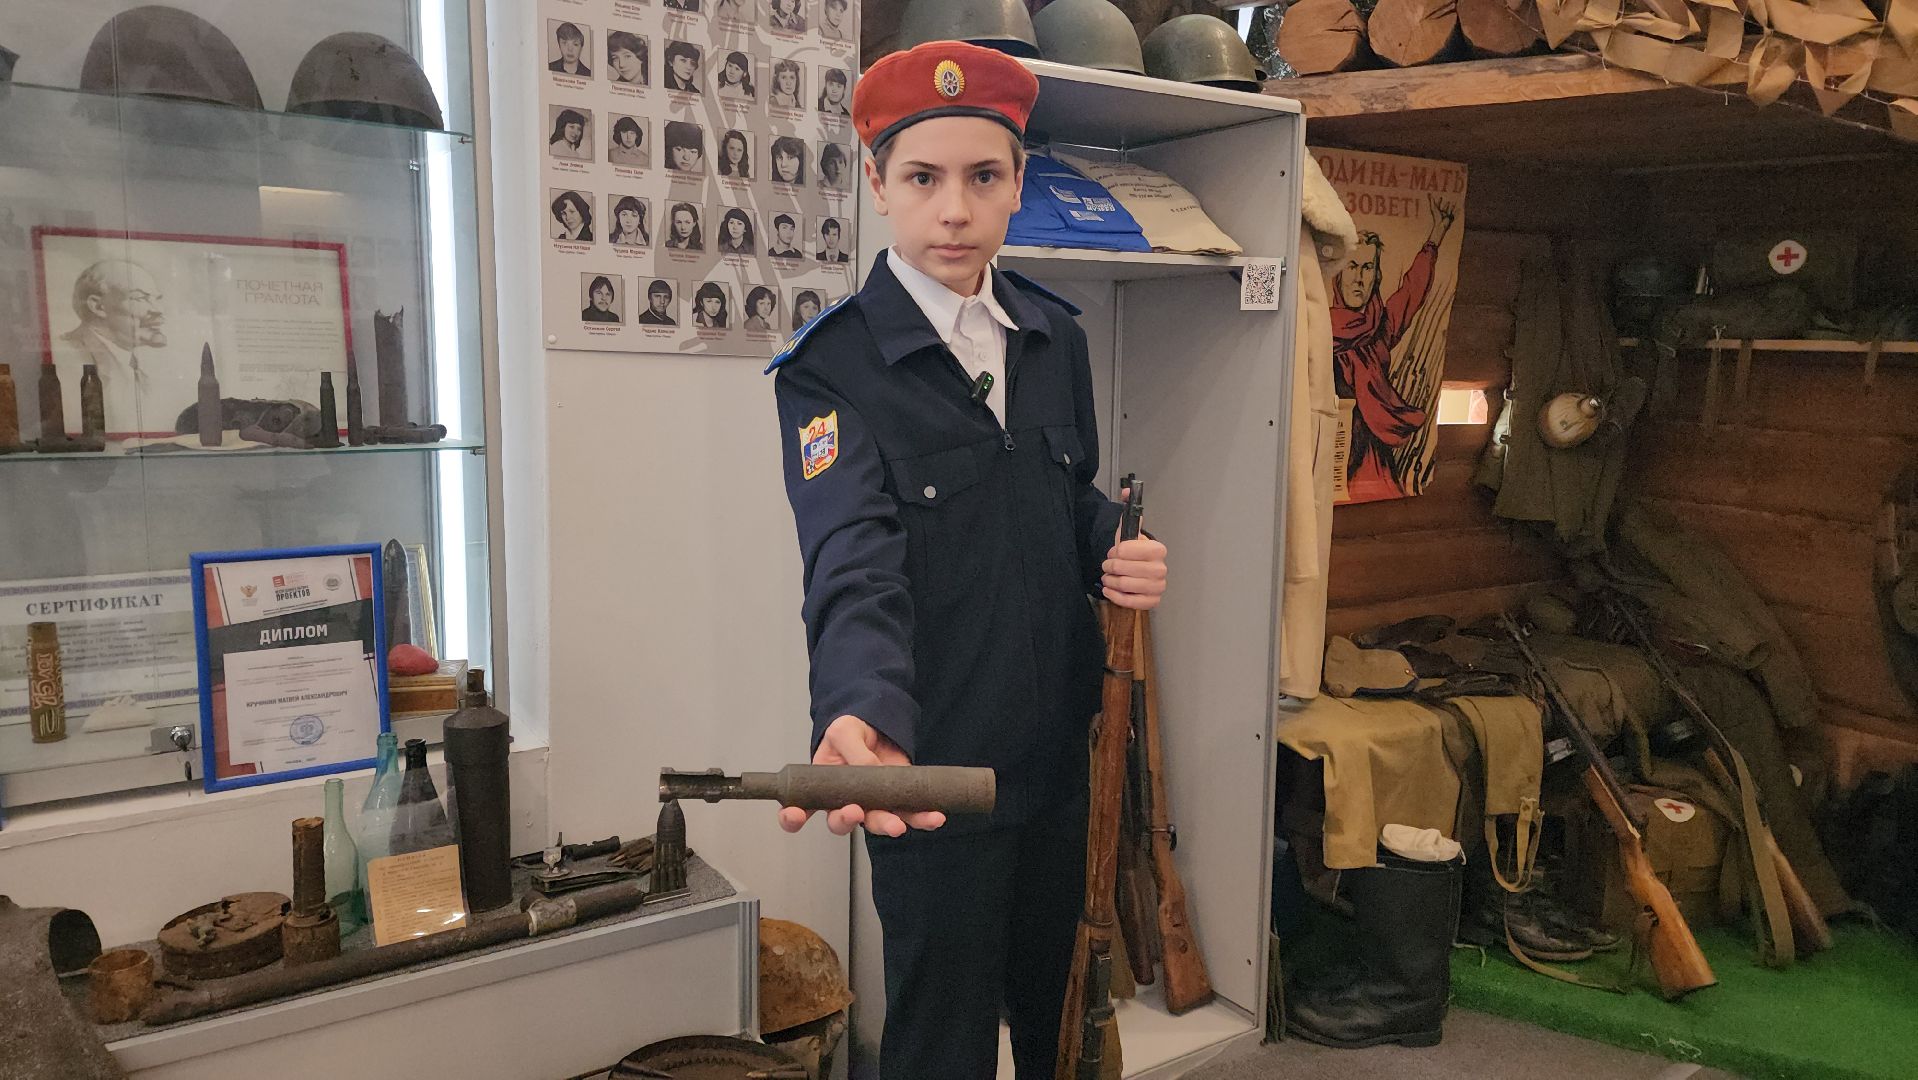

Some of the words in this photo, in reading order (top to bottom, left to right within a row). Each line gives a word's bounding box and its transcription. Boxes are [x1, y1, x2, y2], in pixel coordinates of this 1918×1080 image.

[1319, 155, 1465, 194] ОДИНА-МАТЬ
[1345, 191, 1420, 217] ЗОВЕТ!
[236, 279, 324, 293] ПОЧЕТНАЯ
[244, 292, 321, 305] ГРАМОТА
[26, 593, 164, 616] СЕРТИФИКАТ
[275, 588, 311, 602] ПРОЕКТОВ
[259, 623, 328, 646] ДИПЛОМ
